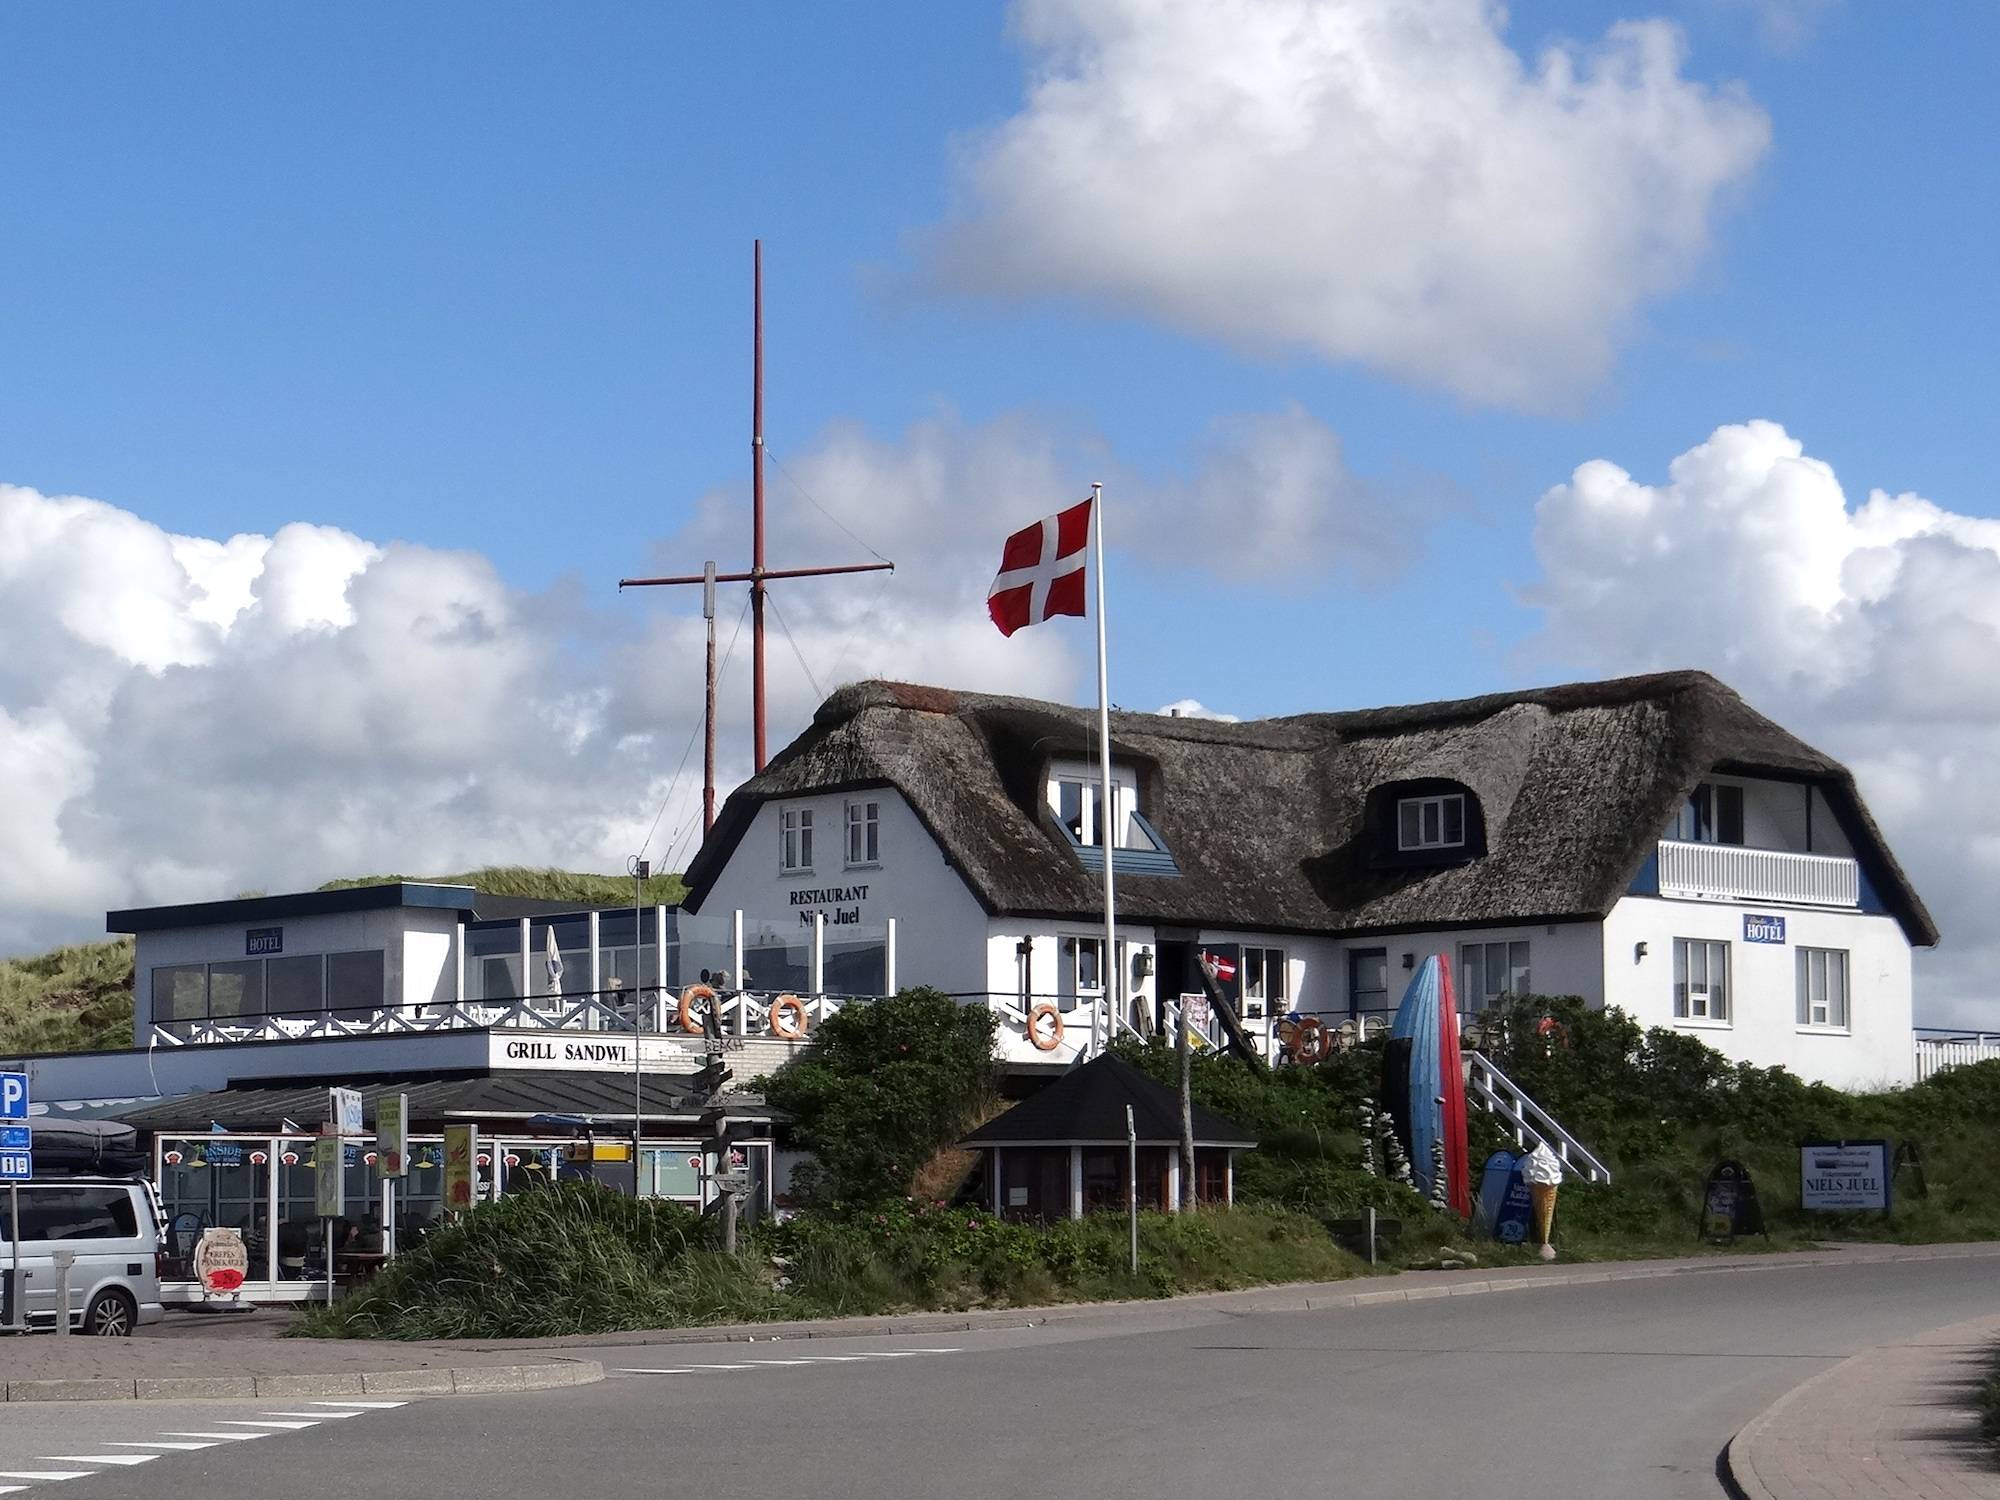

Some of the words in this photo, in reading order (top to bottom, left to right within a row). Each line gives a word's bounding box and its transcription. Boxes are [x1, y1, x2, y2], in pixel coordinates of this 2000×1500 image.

[789, 885, 869, 906] RESTAURANT
[833, 906, 859, 925] Juel
[1747, 923, 1784, 941] HOTEL
[250, 936, 281, 951] HOTEL
[506, 1041, 557, 1060] GRILL
[704, 1039, 744, 1053] BEACH
[3, 1078, 23, 1114] P
[1806, 1178, 1844, 1191] NIELS
[1846, 1178, 1879, 1191] JUEL
